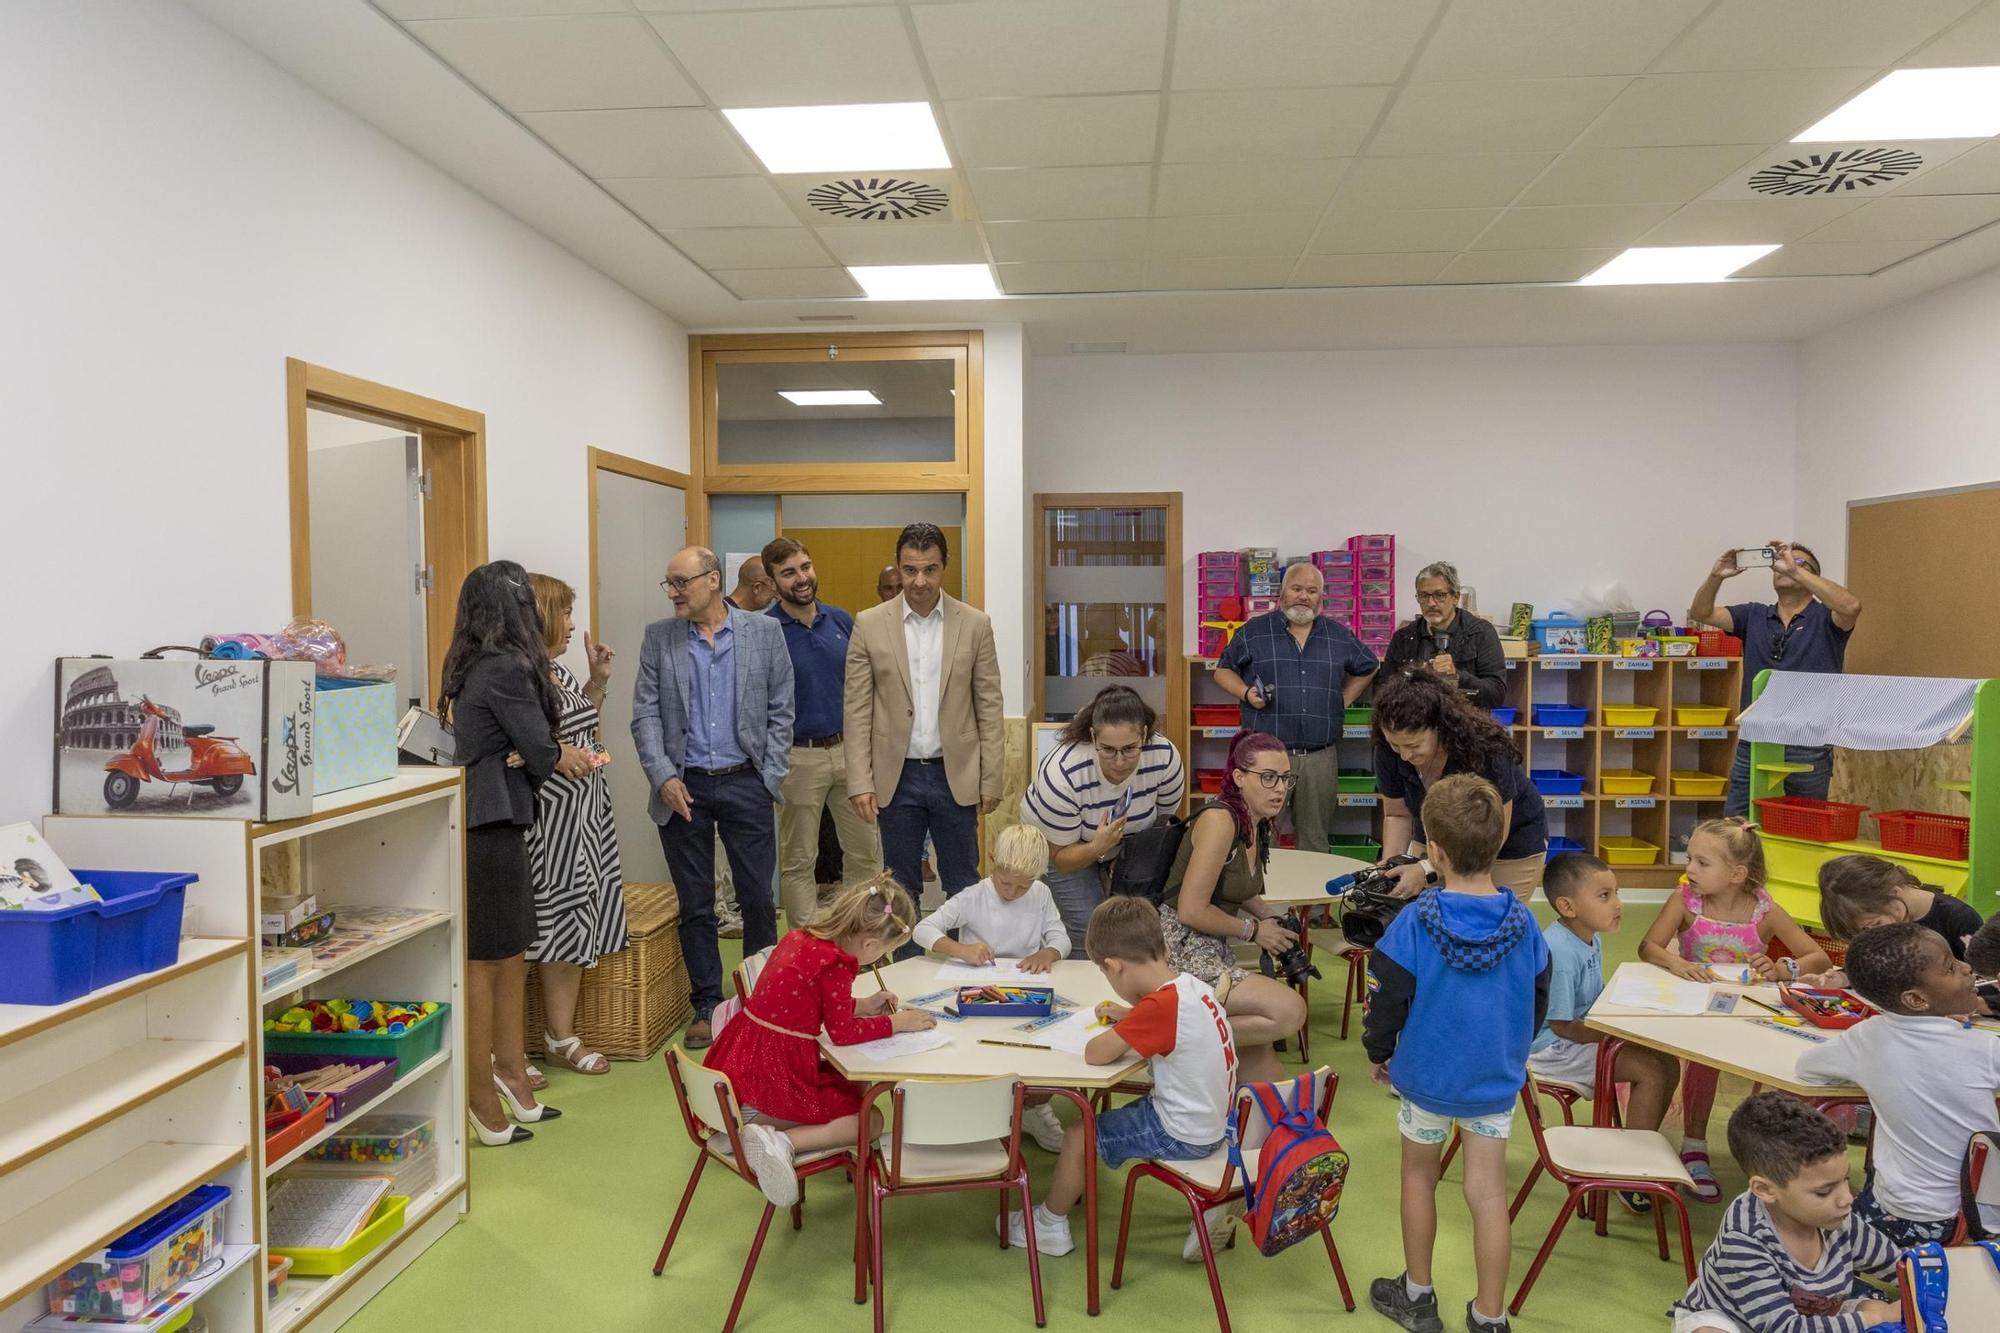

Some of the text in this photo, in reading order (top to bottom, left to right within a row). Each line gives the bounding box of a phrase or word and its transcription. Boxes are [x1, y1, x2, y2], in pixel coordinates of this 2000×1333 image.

[211, 674, 259, 696] Grand Sport
[299, 680, 312, 767] Grand Sport
